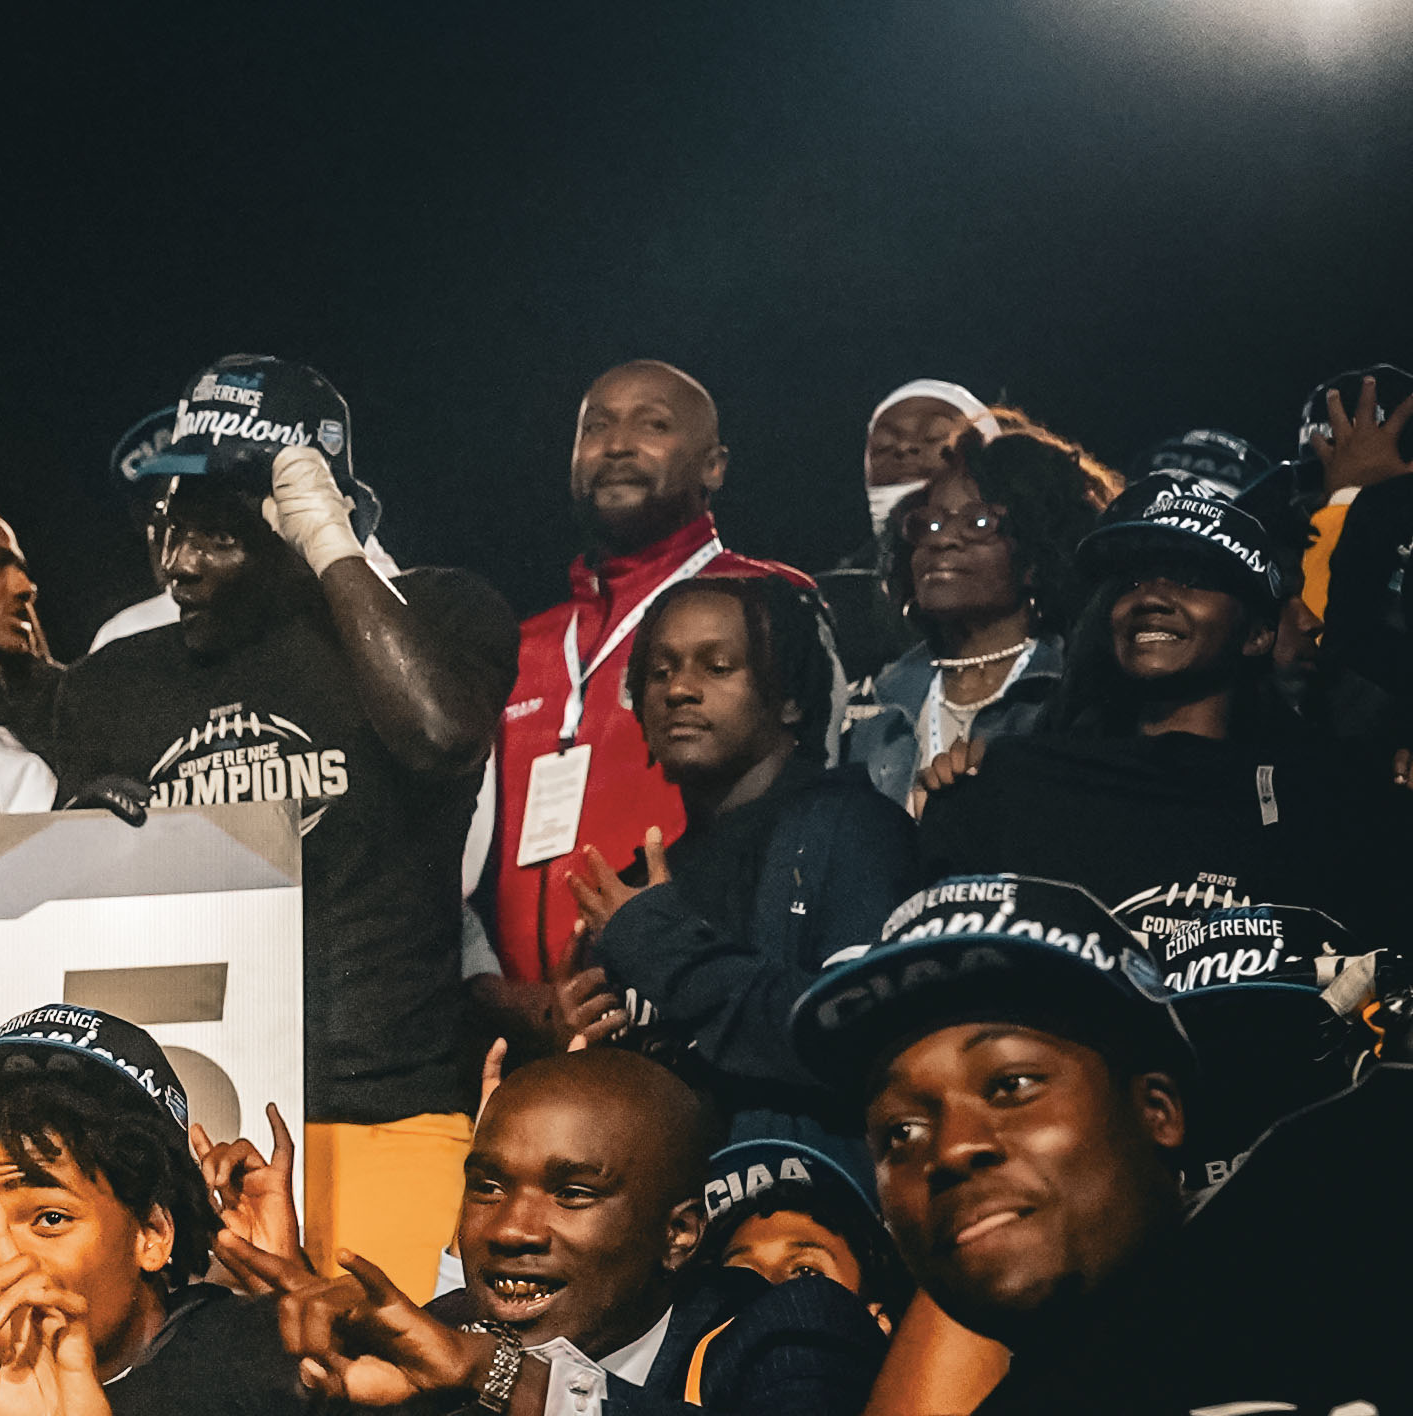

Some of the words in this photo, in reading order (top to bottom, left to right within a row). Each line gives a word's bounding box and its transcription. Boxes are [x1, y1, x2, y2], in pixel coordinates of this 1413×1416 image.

[149, 749, 349, 808] HAMPIONS
[1196, 871, 1238, 887] 2025
[1165, 917, 1284, 961] CONFERENCE
[704, 1157, 811, 1222] CIAA
